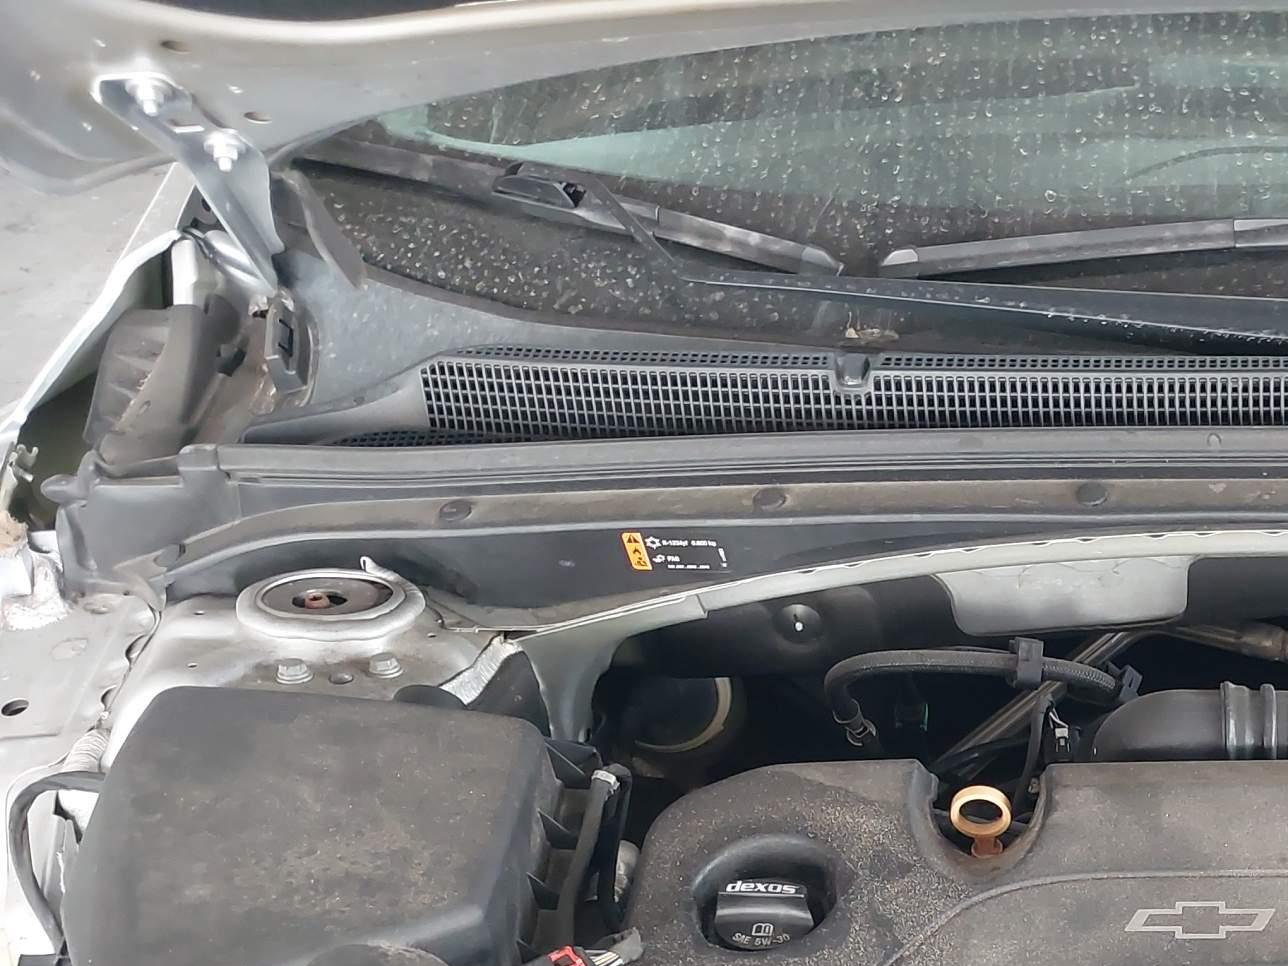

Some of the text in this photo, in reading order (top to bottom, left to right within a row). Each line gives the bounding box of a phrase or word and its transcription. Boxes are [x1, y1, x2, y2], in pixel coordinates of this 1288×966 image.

[726, 880, 800, 894] dexos
[732, 932, 791, 946] SAE 5W-30
